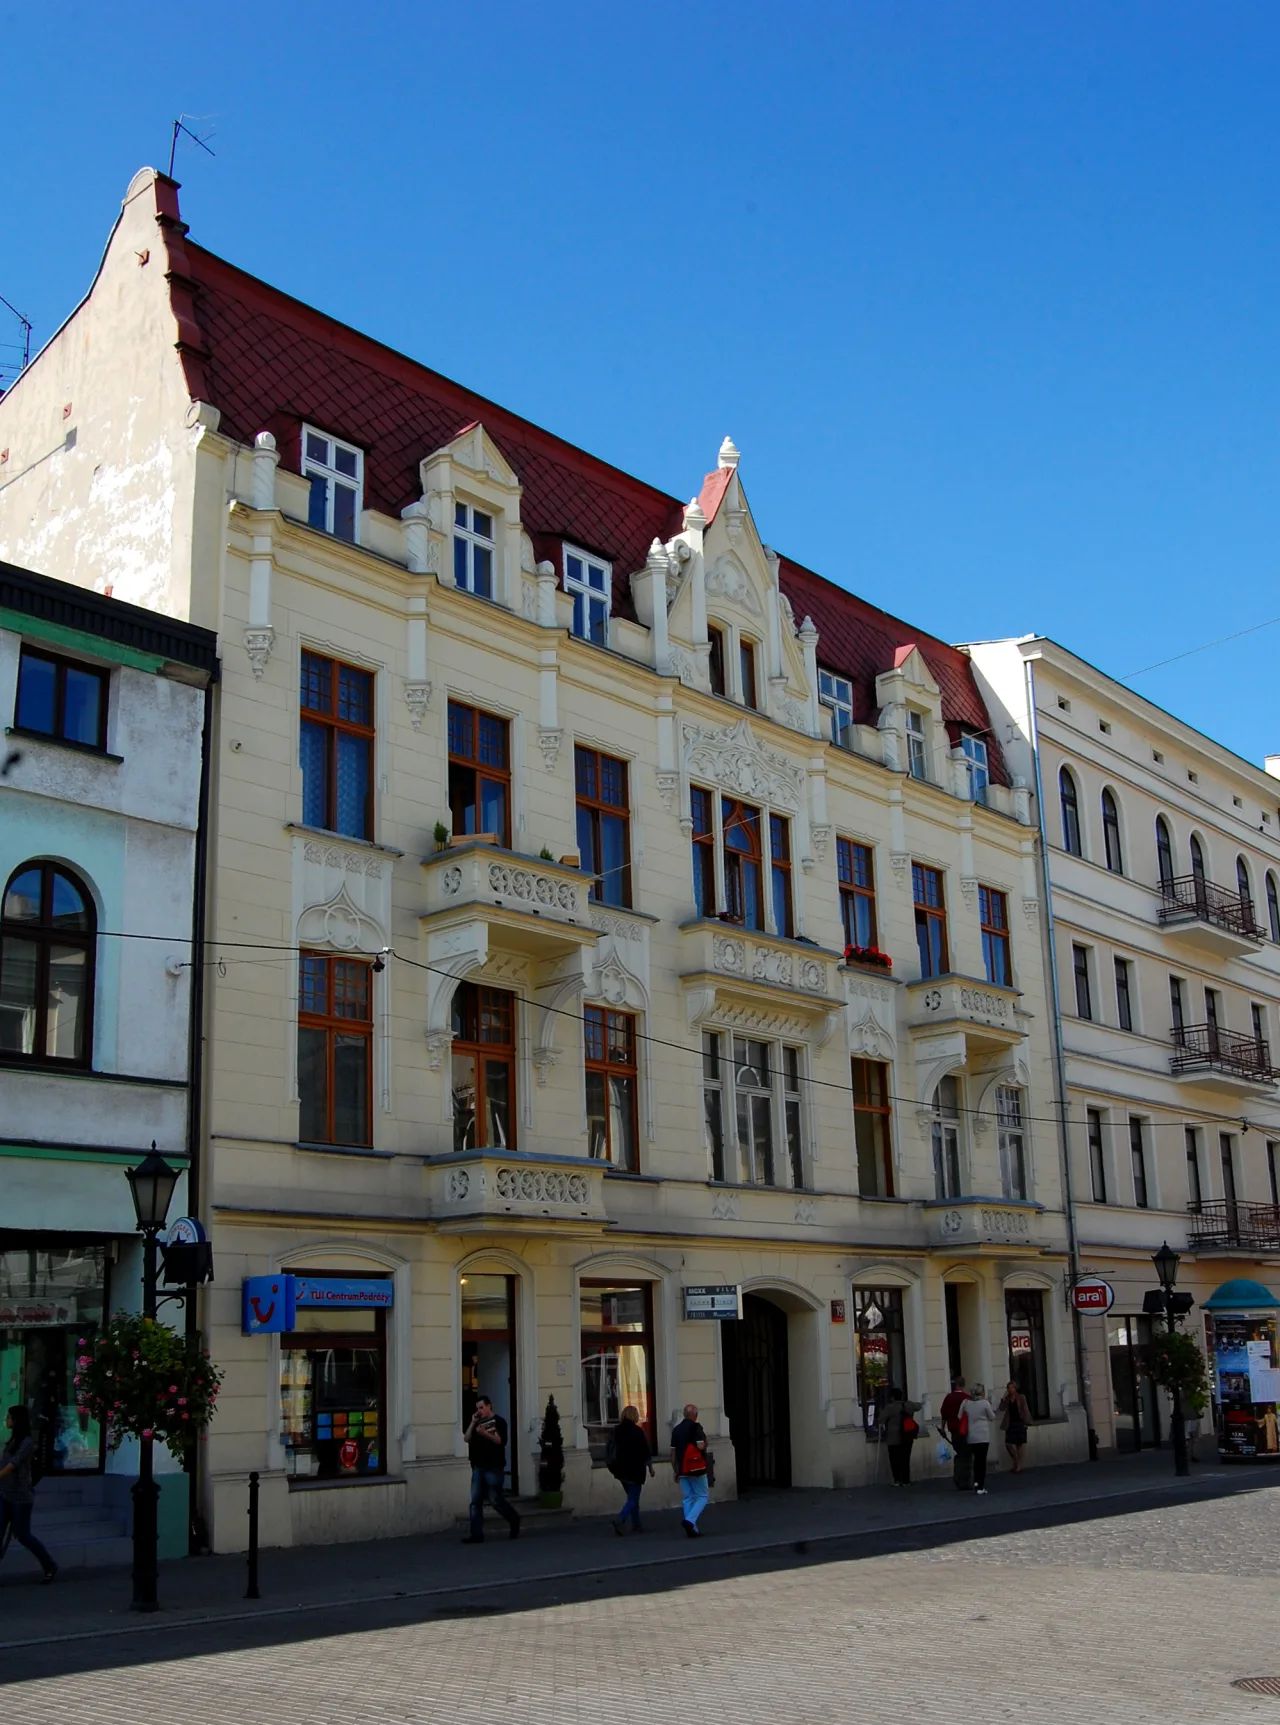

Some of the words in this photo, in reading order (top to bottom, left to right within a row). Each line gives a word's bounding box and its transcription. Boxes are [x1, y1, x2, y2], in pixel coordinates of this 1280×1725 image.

[311, 1291, 324, 1299] TUI
[1078, 1292, 1099, 1302] ara
[1011, 1335, 1031, 1348] ara
